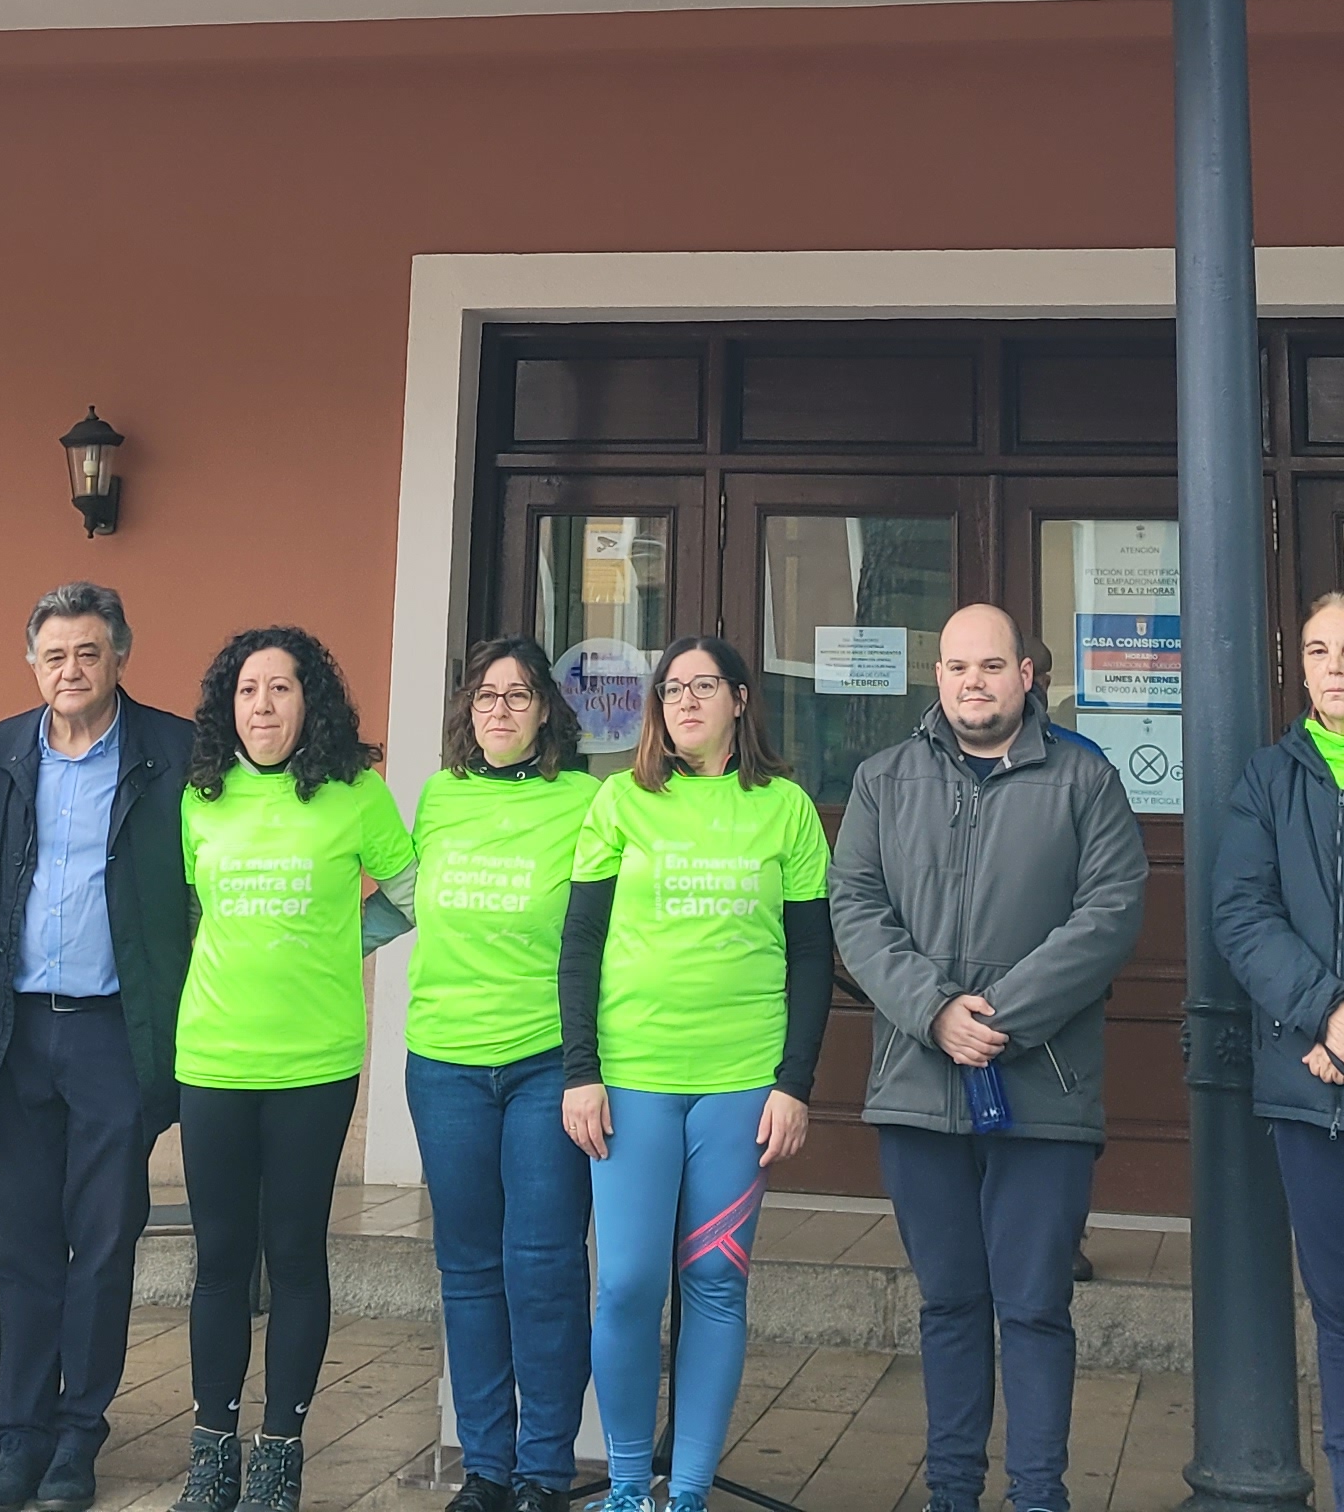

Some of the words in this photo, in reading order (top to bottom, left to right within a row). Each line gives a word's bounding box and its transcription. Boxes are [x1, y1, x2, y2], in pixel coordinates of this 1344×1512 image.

[1120, 546, 1160, 554] ATENCIÓN
[1085, 568, 1123, 576] PETICIÓN
[1082, 637, 1114, 647] CASA
[1116, 638, 1181, 648] CONSISTOR
[851, 679, 890, 687] FEBRERO
[1104, 675, 1133, 683] LUNES
[1134, 675, 1142, 683] A
[1142, 676, 1180, 684] VIERNES
[1143, 797, 1149, 805] Y
[1150, 797, 1180, 805] BICICLE
[447, 851, 468, 865] En
[470, 854, 536, 870] marcha
[664, 853, 688, 869] En
[691, 855, 761, 870] marcha
[218, 873, 287, 891] contra
[291, 872, 312, 891] el
[442, 869, 508, 887] contra
[511, 871, 532, 889] el
[664, 872, 737, 891] contra
[740, 873, 761, 892] el
[219, 892, 313, 917] cáncer
[437, 886, 531, 912] cáncer
[664, 892, 760, 917] cáncer
